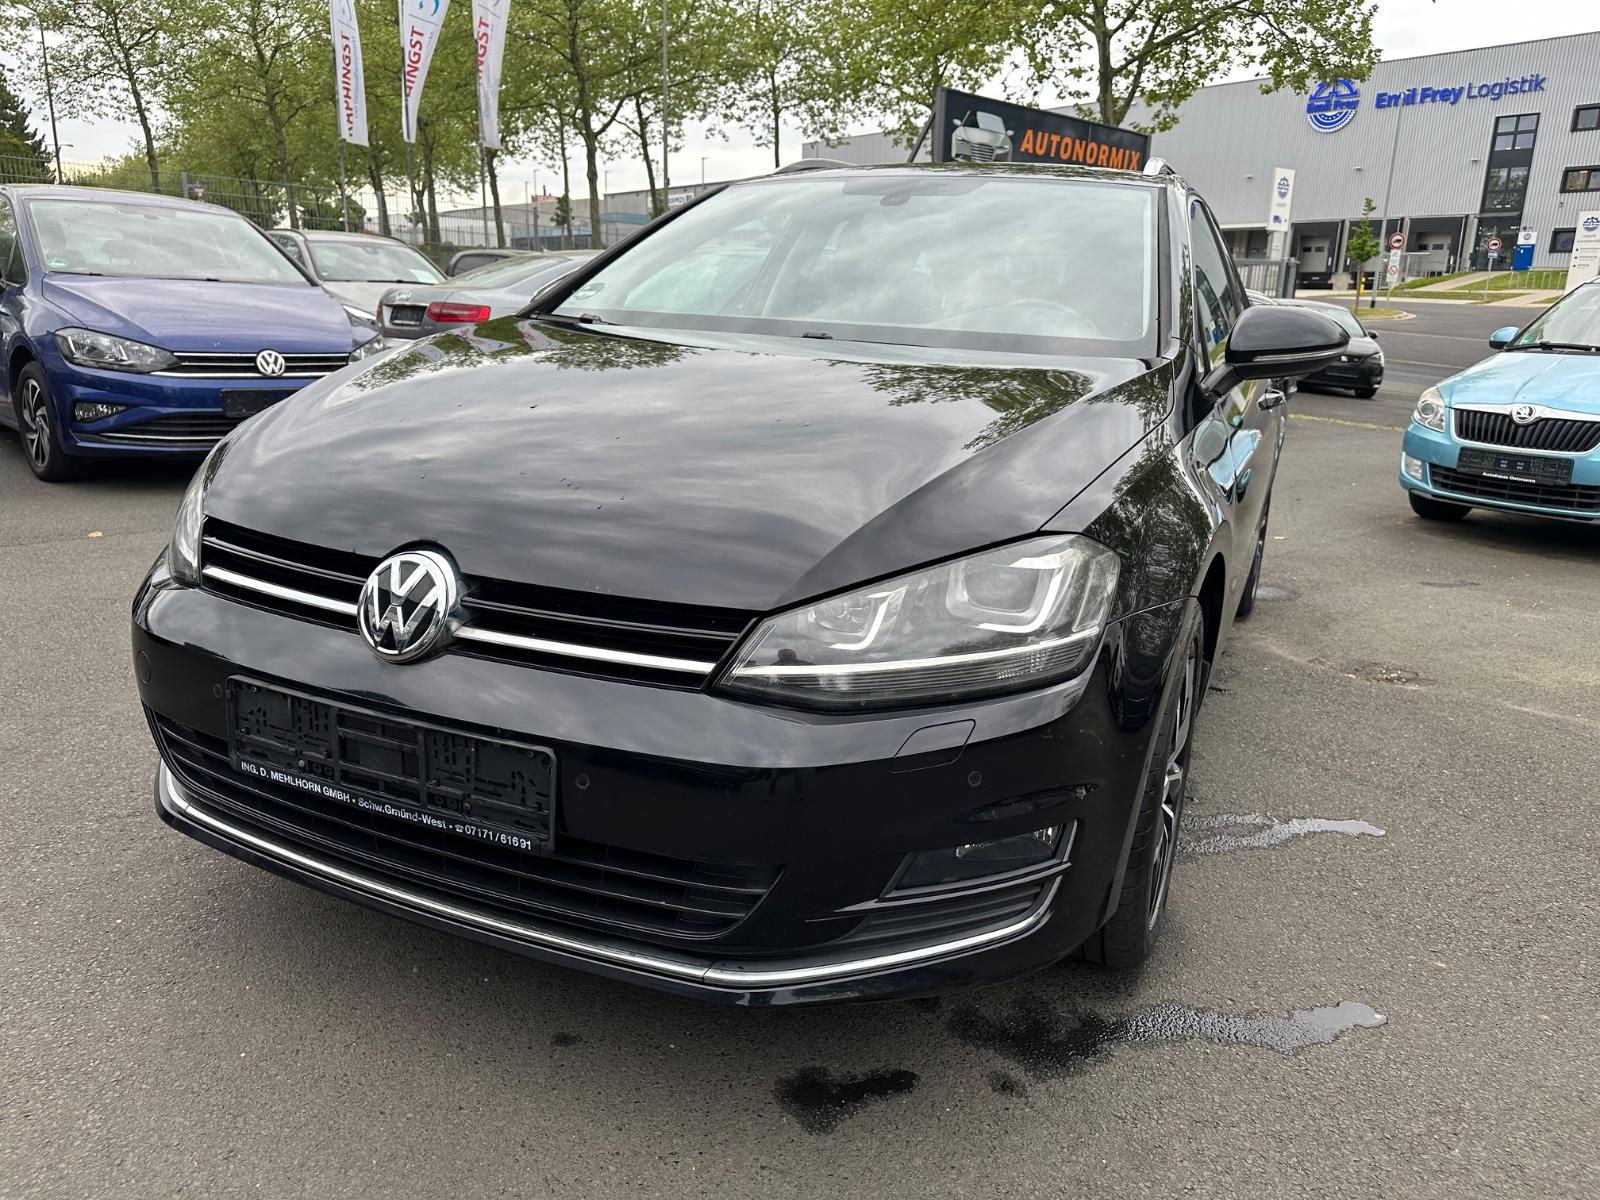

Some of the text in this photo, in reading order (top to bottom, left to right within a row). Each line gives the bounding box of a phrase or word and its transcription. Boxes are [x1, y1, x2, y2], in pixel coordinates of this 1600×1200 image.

[340, 30, 355, 137] APHINGST
[1375, 74, 1546, 109] Emil Frey Logistik
[1020, 128, 1141, 171] AUTONORMIX
[241, 761, 258, 775] ING.
[260, 767, 269, 778] D.
[270, 770, 322, 794] MEHLHORN
[323, 786, 350, 803] GMBH
